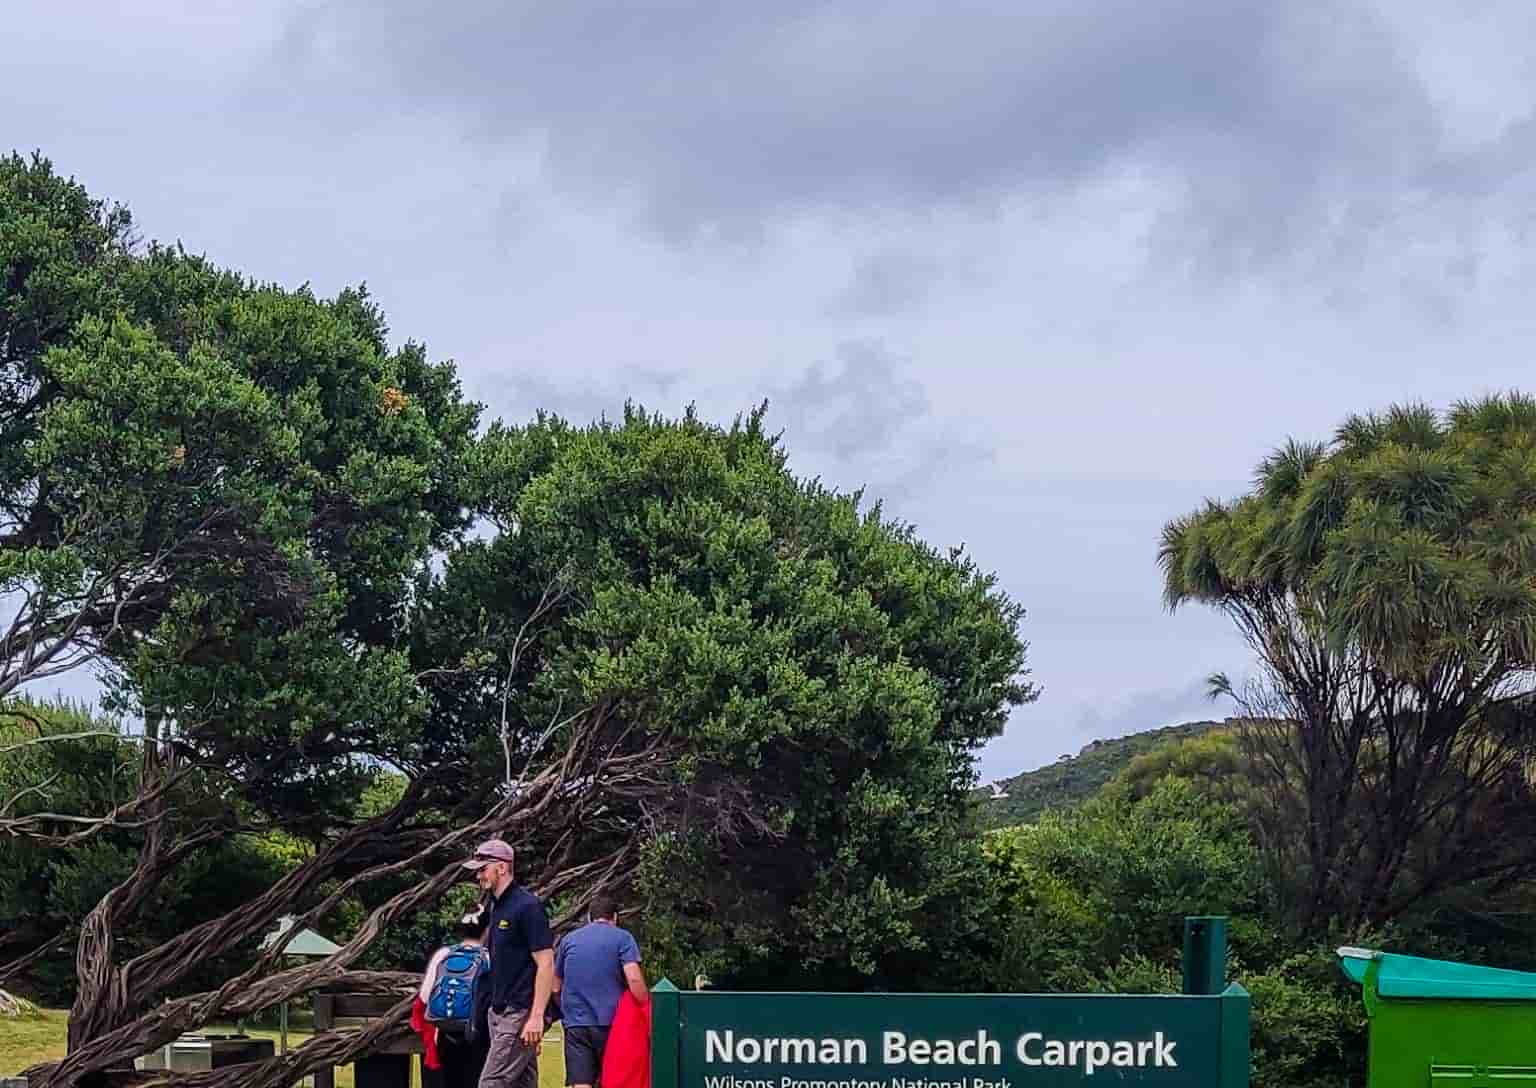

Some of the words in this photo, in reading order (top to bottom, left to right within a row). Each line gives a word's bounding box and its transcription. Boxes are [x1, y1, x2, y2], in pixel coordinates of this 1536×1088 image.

[704, 1030, 867, 1065] Norman
[883, 1030, 1001, 1066] Beach
[1016, 1031, 1178, 1075] Carpark
